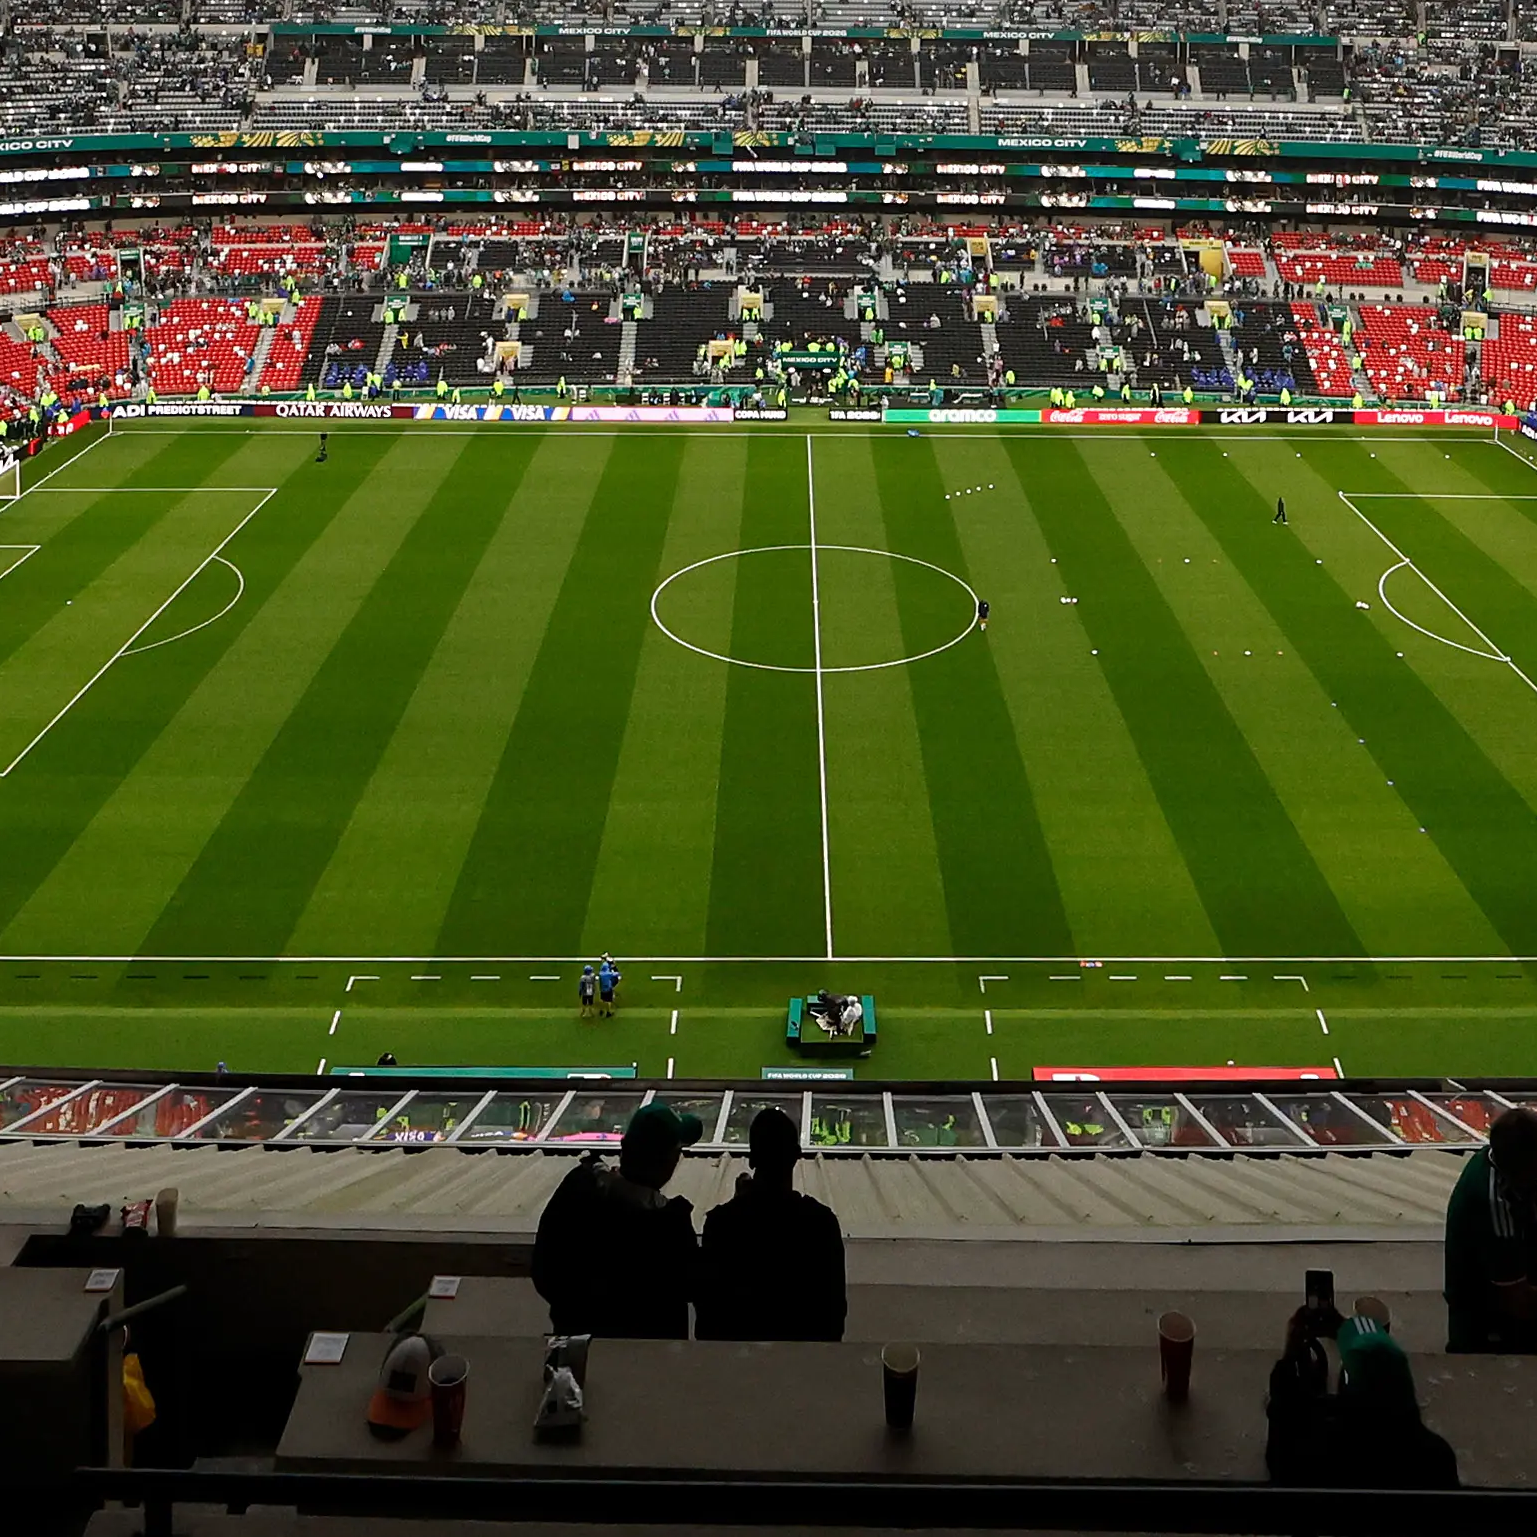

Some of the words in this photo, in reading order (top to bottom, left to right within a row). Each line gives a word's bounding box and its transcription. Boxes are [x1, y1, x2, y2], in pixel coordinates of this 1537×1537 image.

[558, 27, 602, 35] MEXICO
[604, 27, 631, 35] CITY
[983, 31, 1027, 39] MEXICO
[36, 139, 73, 149] CITY
[997, 138, 1052, 147] MEXICO
[1054, 138, 1087, 148] CITY
[1351, 205, 1378, 215] CITY
[112, 404, 145, 418] ADI
[275, 404, 325, 418] QATAR
[329, 404, 391, 418] AIRWAYS
[444, 405, 478, 420] VISA
[513, 405, 545, 420] VISA
[735, 410, 759, 419] COPA
[929, 409, 997, 422] aramco
[1377, 412, 1424, 424] Lenovo
[1444, 412, 1493, 426] Lenovo
